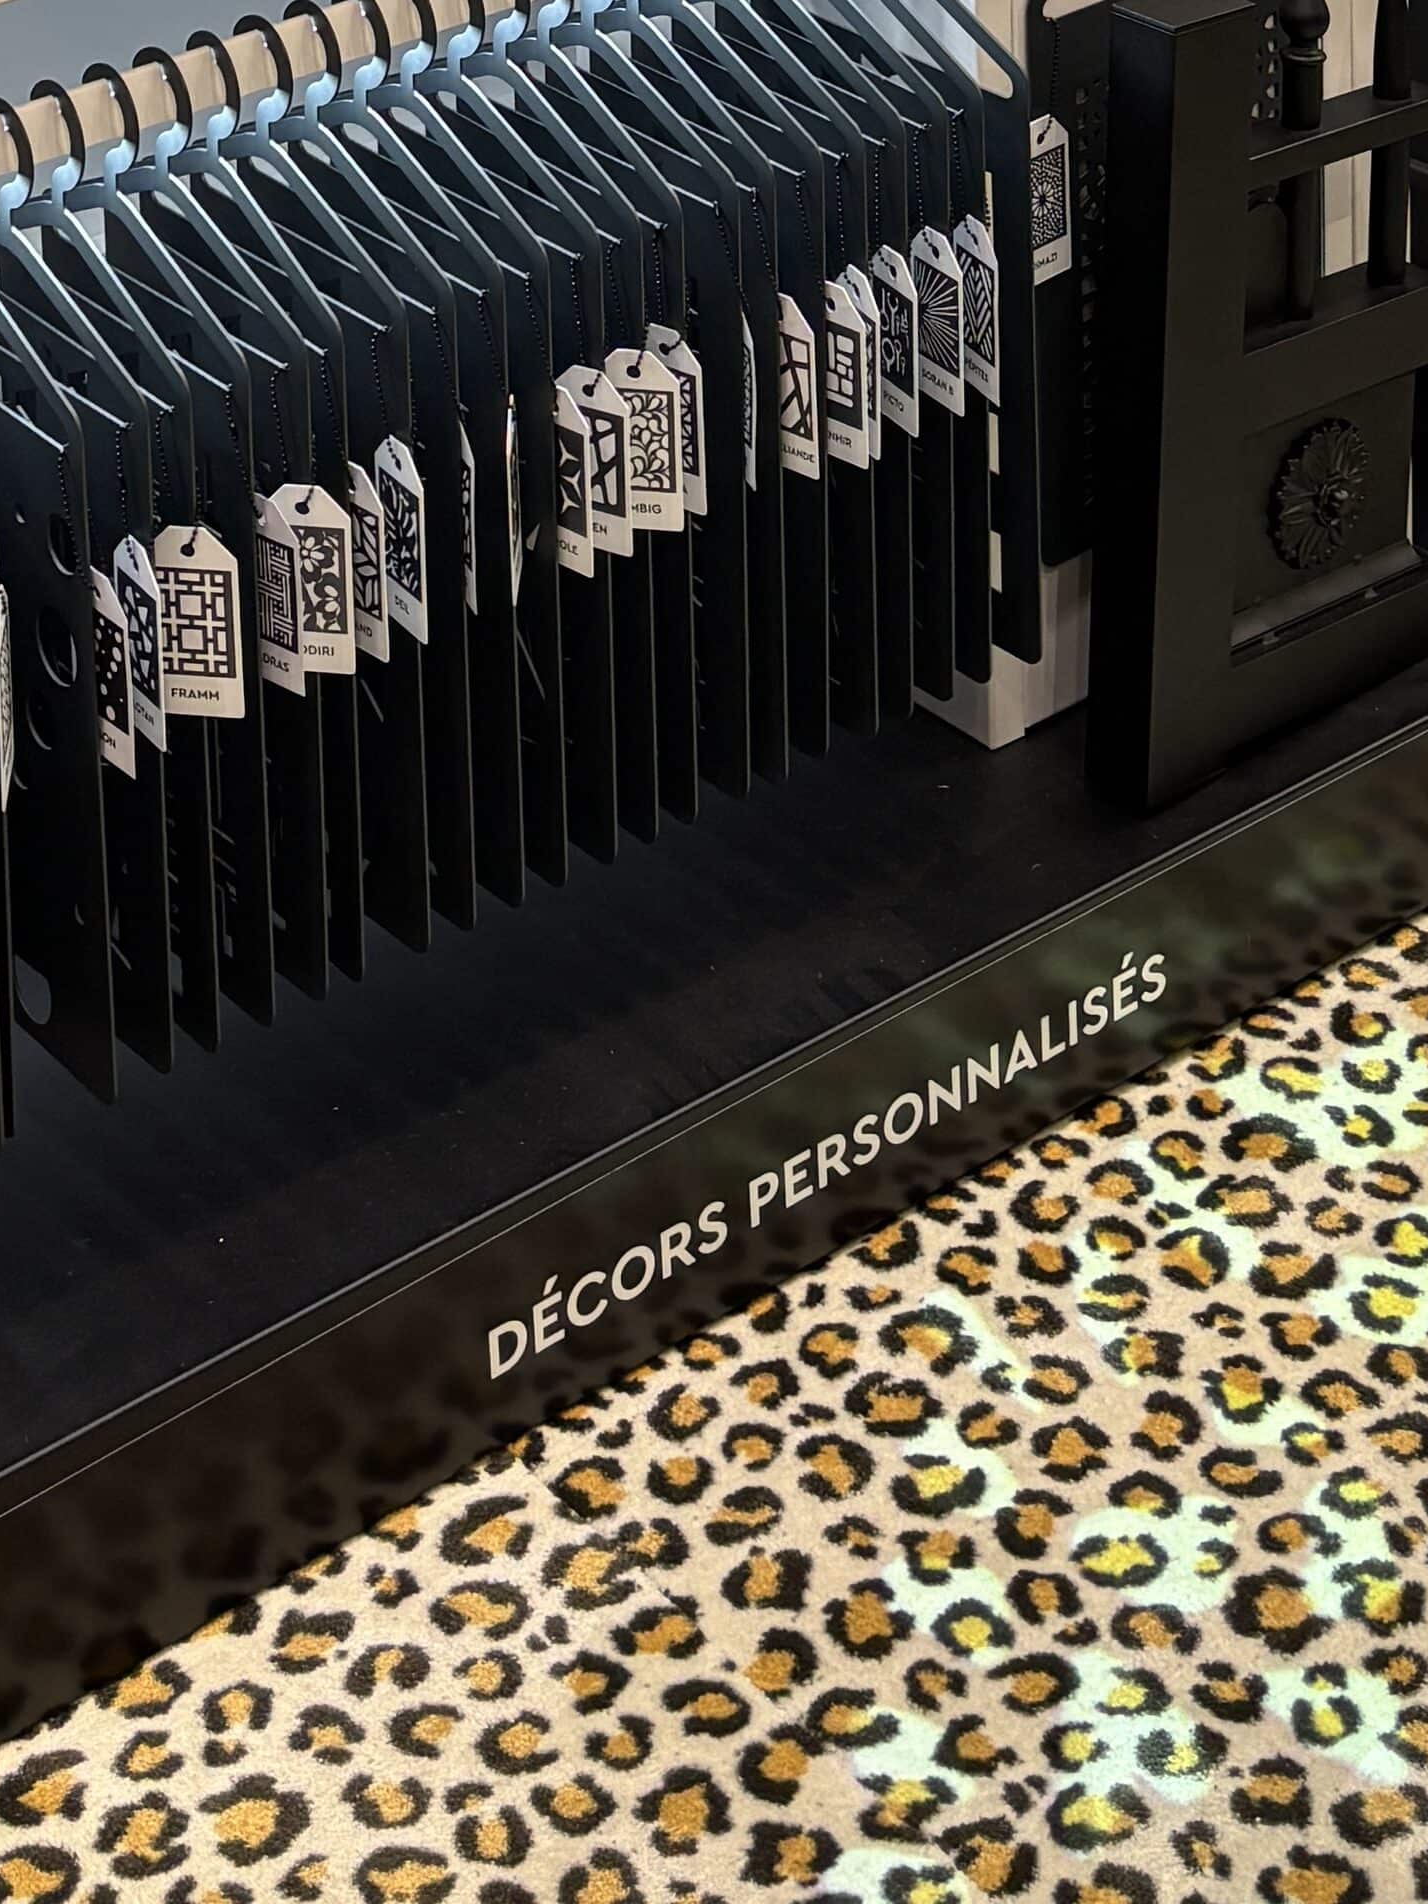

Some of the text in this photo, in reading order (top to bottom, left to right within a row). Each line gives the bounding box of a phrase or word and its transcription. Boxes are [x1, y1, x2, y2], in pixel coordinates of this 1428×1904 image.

[171, 688, 220, 701] FRAMM
[486, 950, 1170, 1380] DÉCORS PERSONNALISÉS
